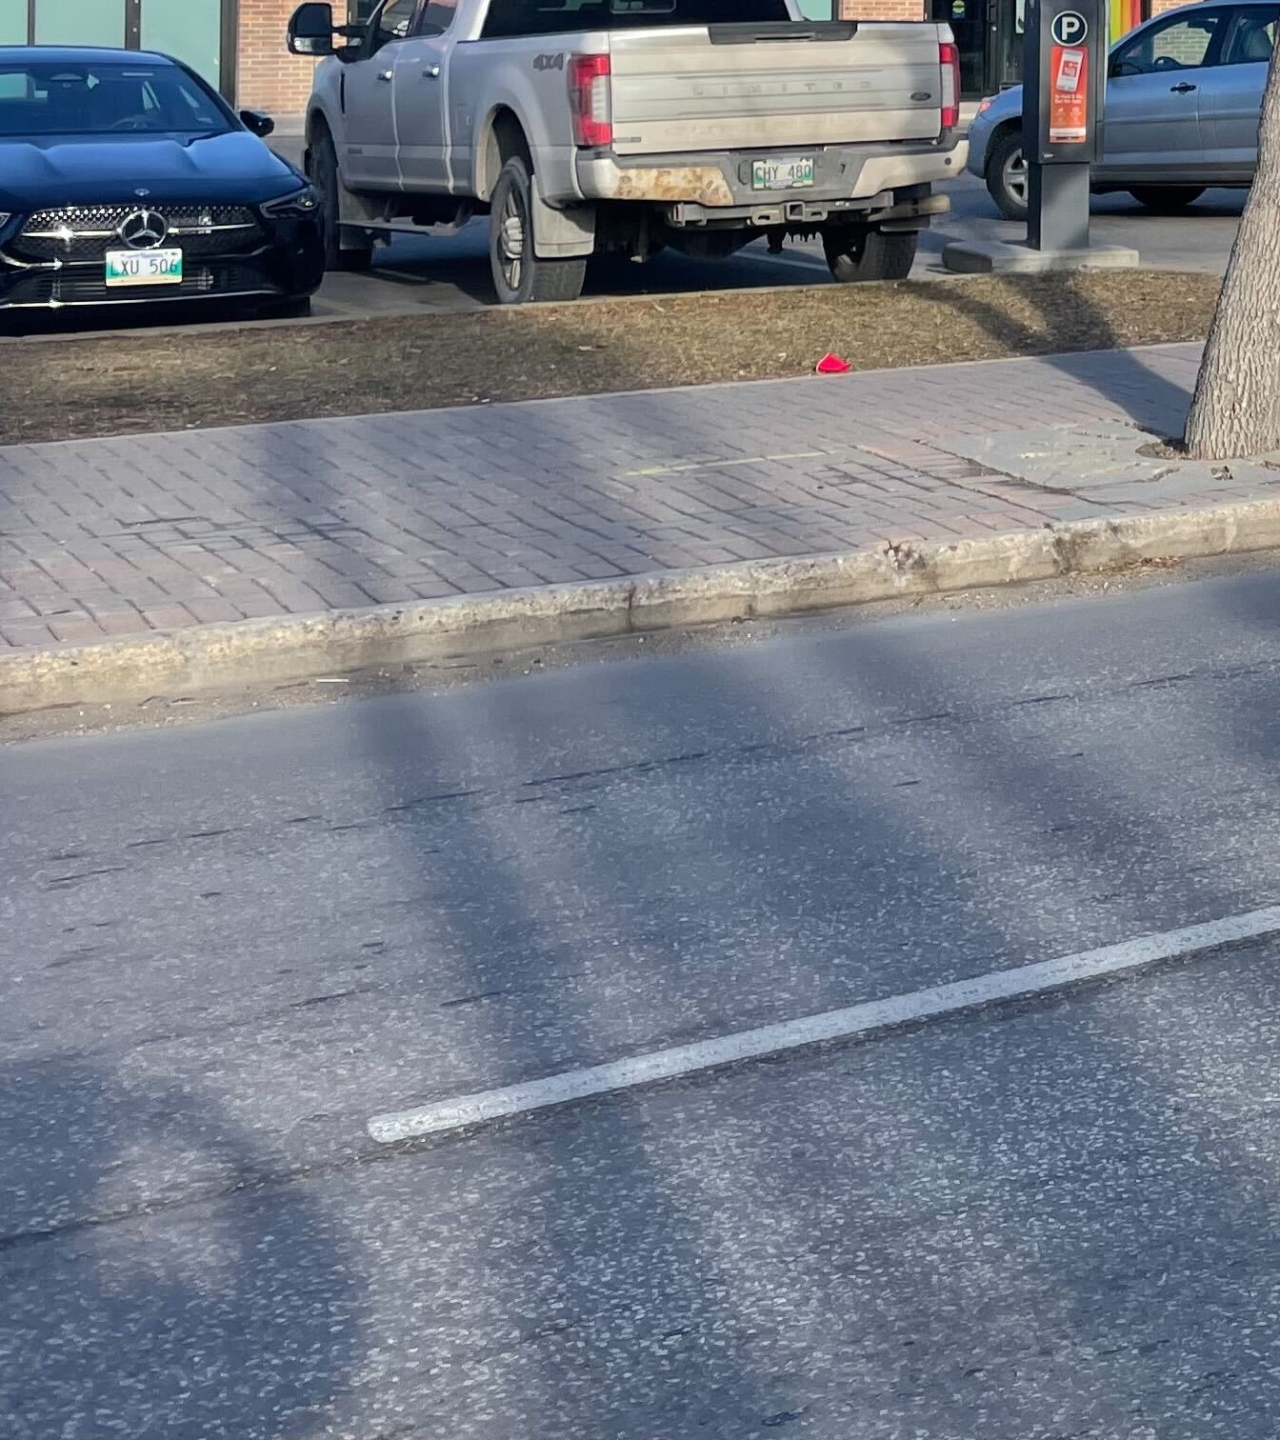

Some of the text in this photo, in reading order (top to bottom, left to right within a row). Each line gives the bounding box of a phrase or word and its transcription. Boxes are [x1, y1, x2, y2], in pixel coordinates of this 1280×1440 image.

[1062, 16, 1080, 41] P
[755, 164, 812, 182] CHY 480
[110, 258, 178, 276] LXU 506
